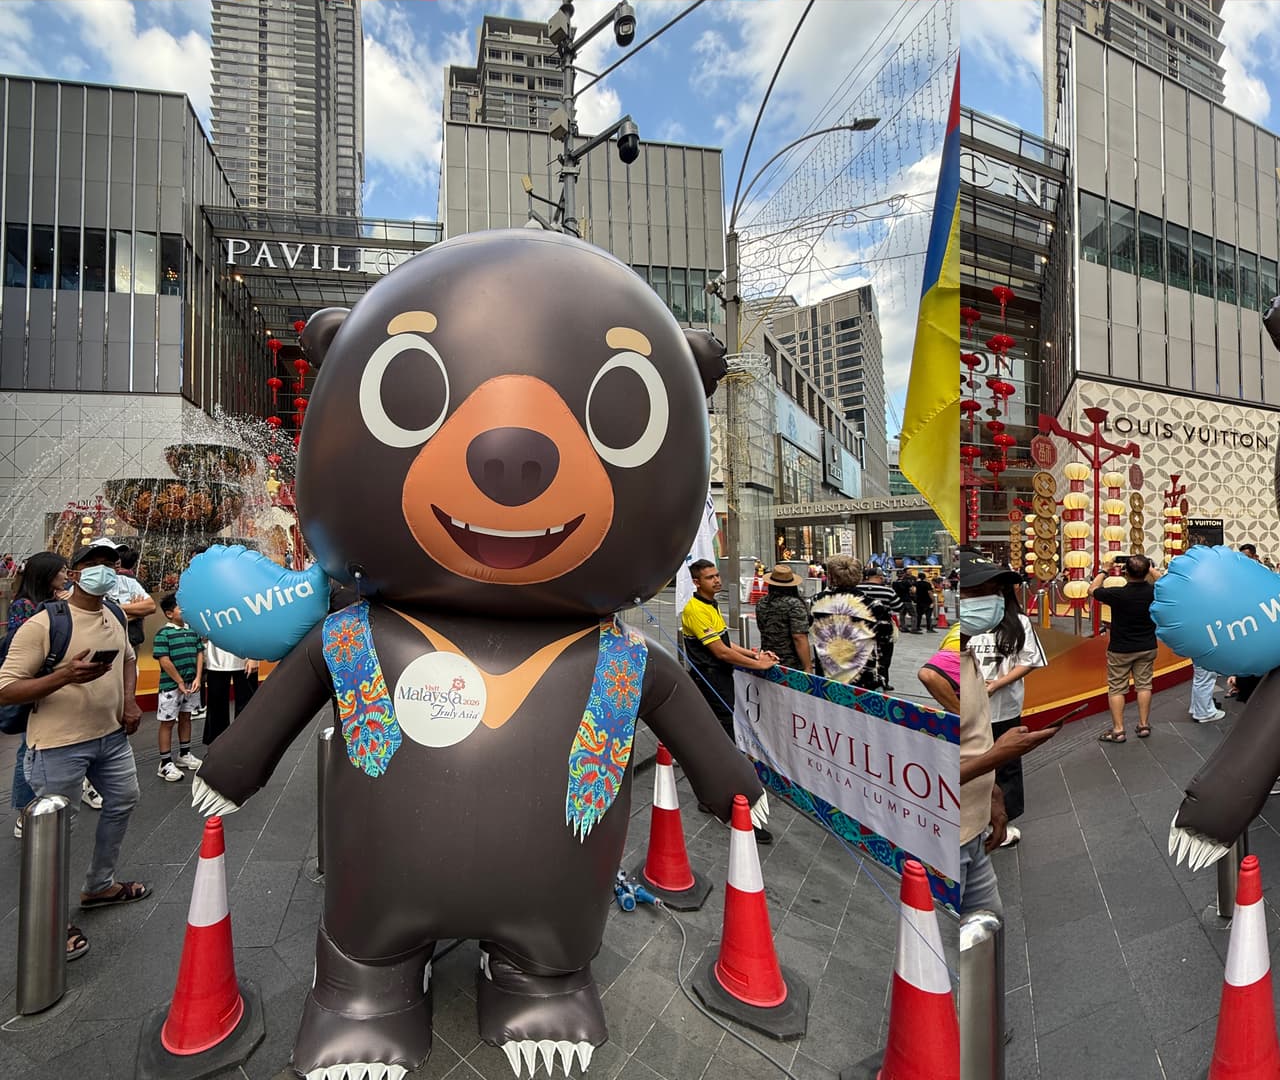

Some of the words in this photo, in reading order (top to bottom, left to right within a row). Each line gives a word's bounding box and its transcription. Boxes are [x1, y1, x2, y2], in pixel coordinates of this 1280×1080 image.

[226, 238, 402, 276] PAVILIO
[1104, 416, 1173, 440] LOUIS
[1183, 423, 1269, 450] VUITTON
[776, 505, 812, 517] BUKIT
[814, 500, 870, 514] BINTANG
[873, 495, 931, 510] ENTRAN
[199, 609, 242, 632] I'm
[243, 580, 315, 616] Wira
[1206, 614, 1258, 646] I'm
[397, 686, 463, 705] Malaysia
[424, 684, 440, 692] Visit
[430, 703, 456, 721] Truly
[458, 711, 479, 720] Asia
[792, 712, 960, 811] PAVILION
[807, 757, 853, 789] KUALA
[863, 786, 942, 838] LUMPUR
